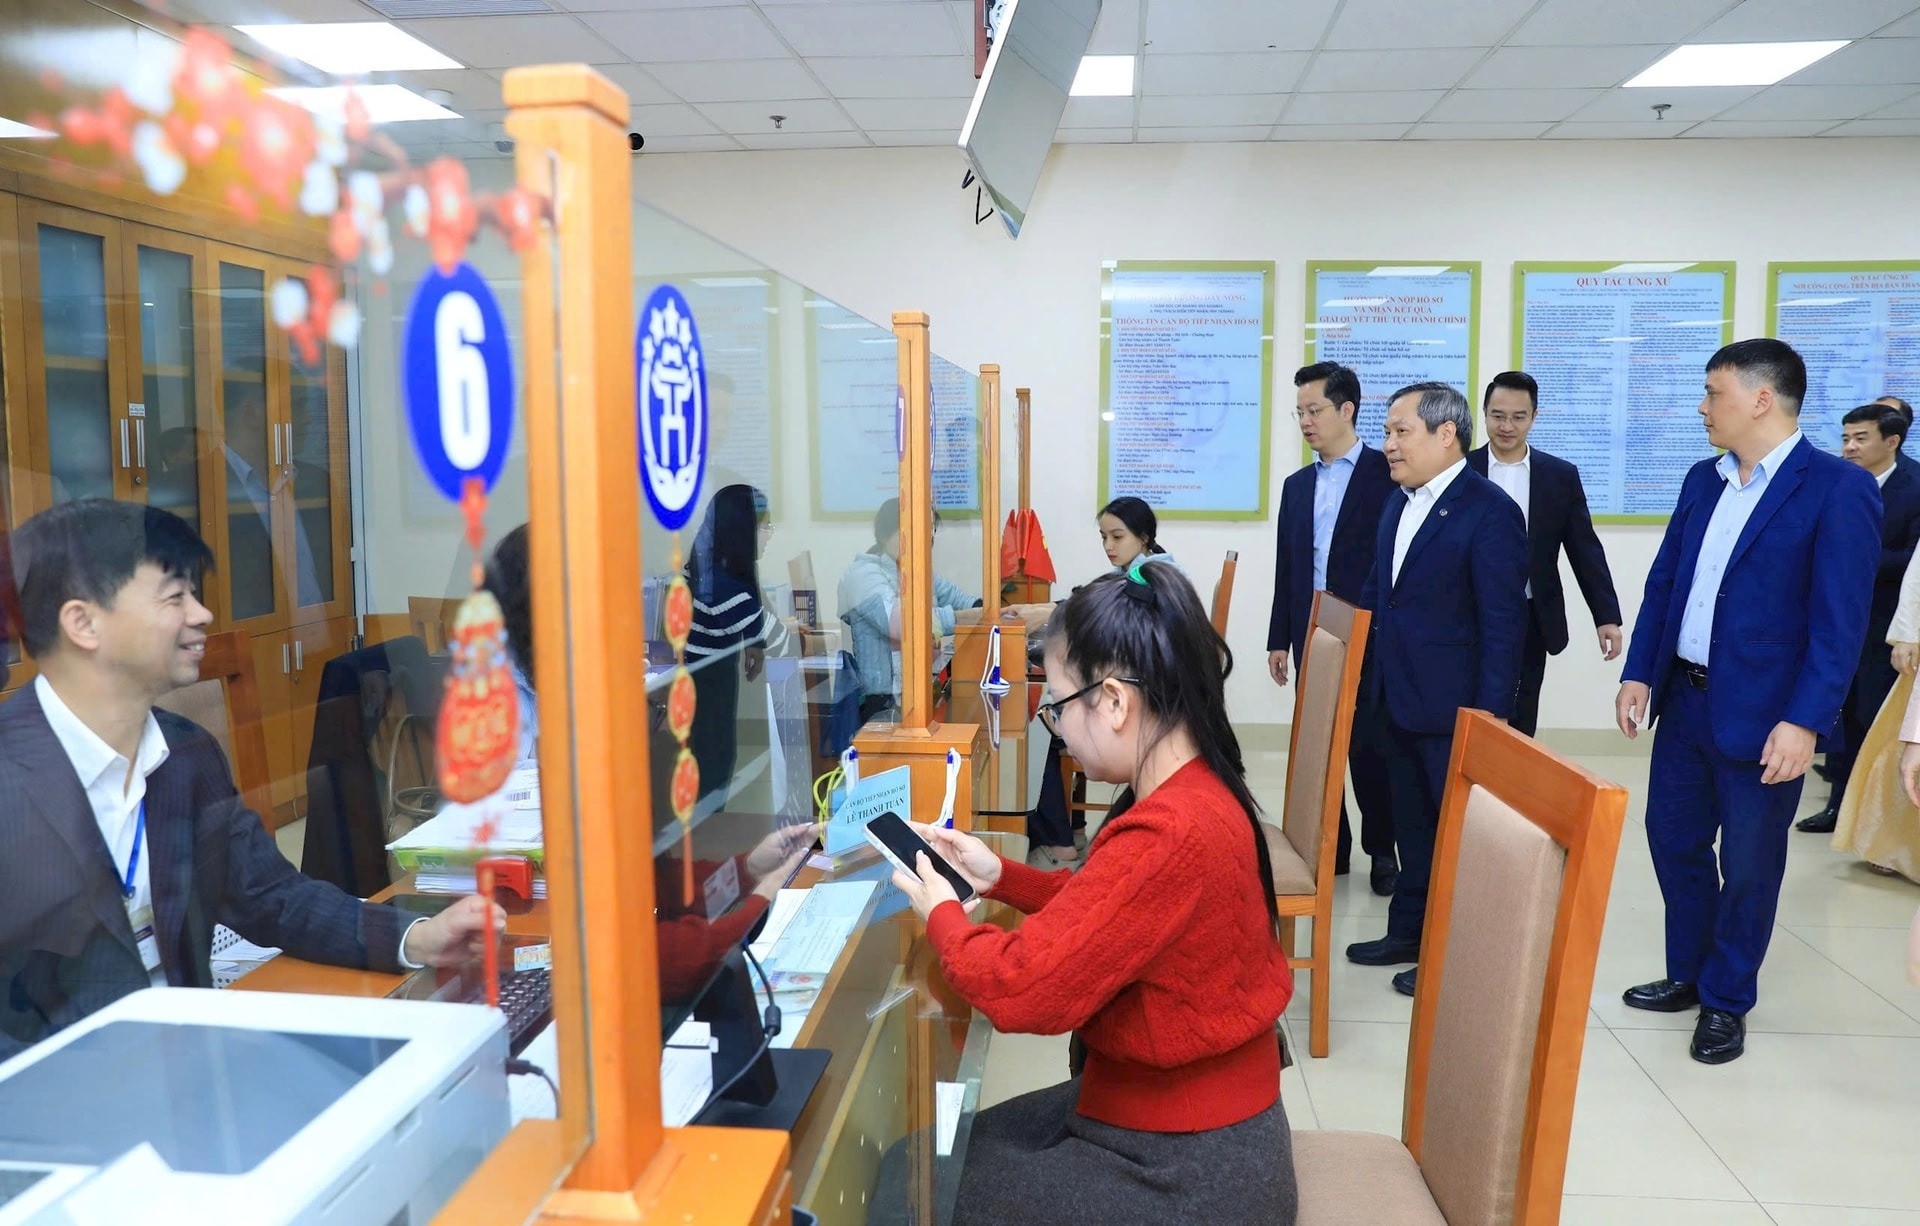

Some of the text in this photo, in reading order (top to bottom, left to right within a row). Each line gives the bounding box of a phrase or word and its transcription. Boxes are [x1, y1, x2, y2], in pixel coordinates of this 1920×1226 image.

[1398, 294, 1416, 305] NỘP
[1417, 294, 1431, 303] HỒ
[1432, 294, 1444, 303] SƠ
[434, 290, 492, 472] 6
[857, 802, 884, 820] THANH
